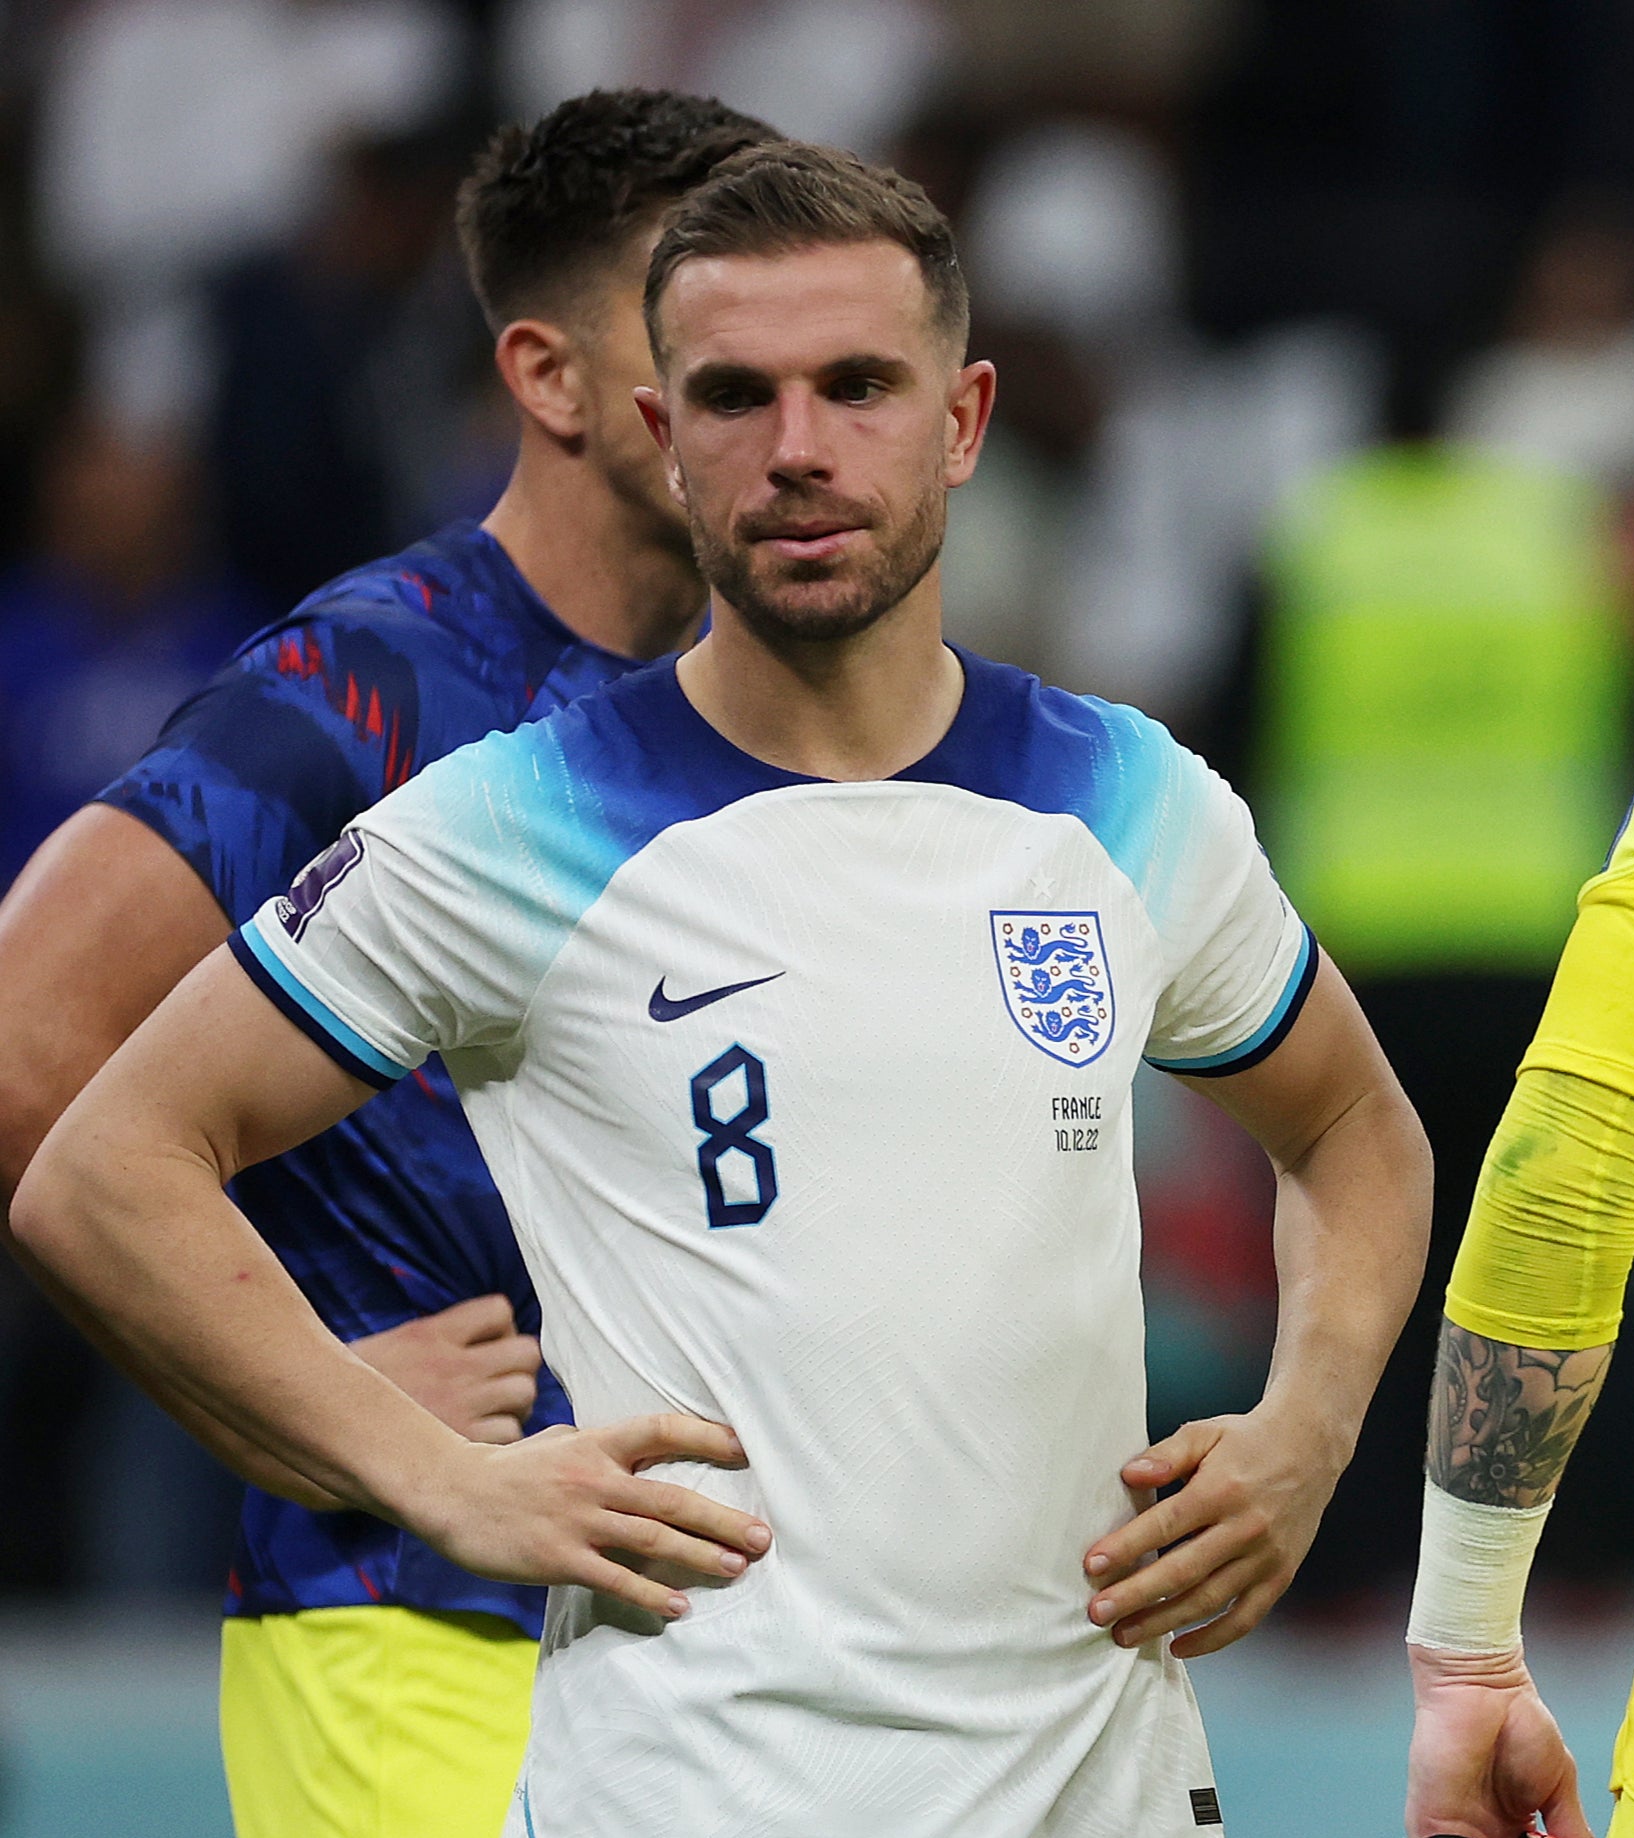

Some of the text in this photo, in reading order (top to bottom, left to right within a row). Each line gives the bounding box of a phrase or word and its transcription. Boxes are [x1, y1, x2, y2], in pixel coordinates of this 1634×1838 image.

[1052, 1096, 1102, 1120] FRANCE
[690, 1042, 778, 1230] 8
[1055, 1128, 1099, 1152] 10.12.22
